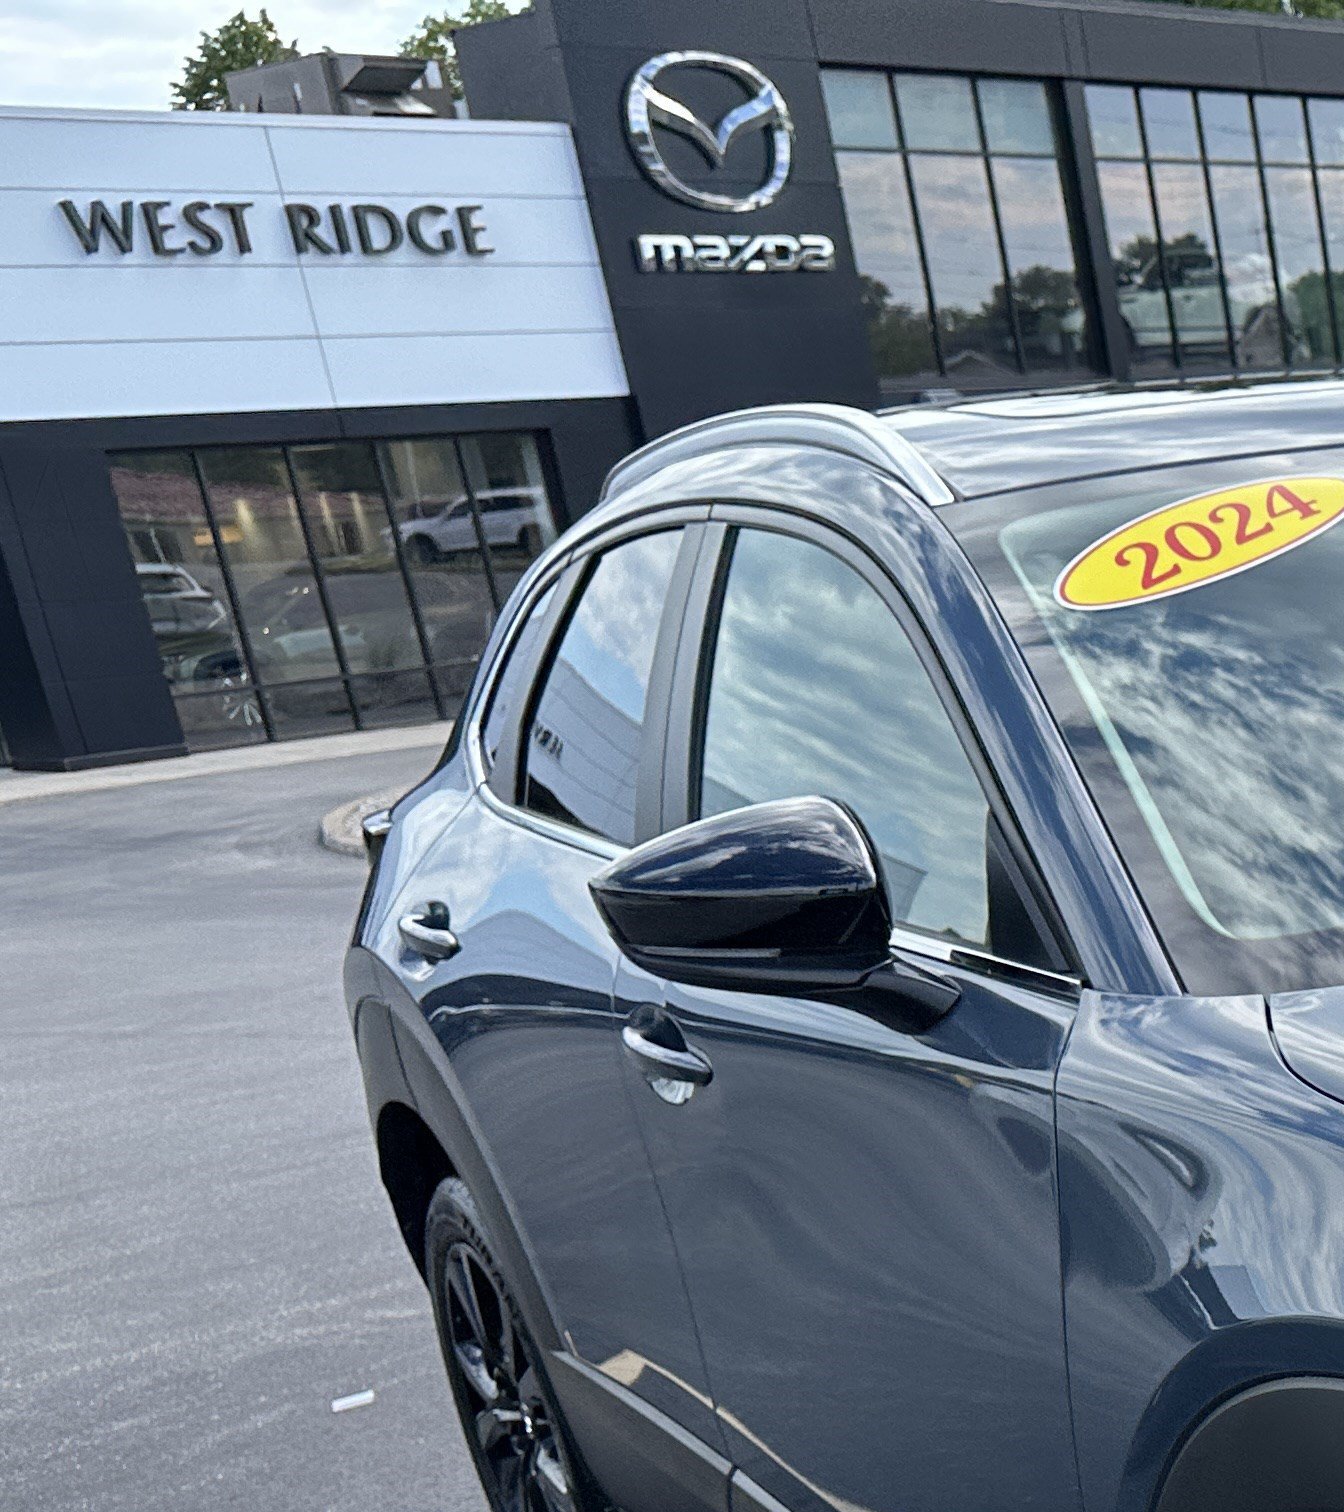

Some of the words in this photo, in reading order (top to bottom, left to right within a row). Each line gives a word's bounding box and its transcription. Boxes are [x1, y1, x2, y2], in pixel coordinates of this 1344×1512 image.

[58, 199, 254, 257] WEST
[284, 203, 496, 257] RIDGE
[635, 233, 838, 273] mazda
[1114, 484, 1322, 590] 2024
